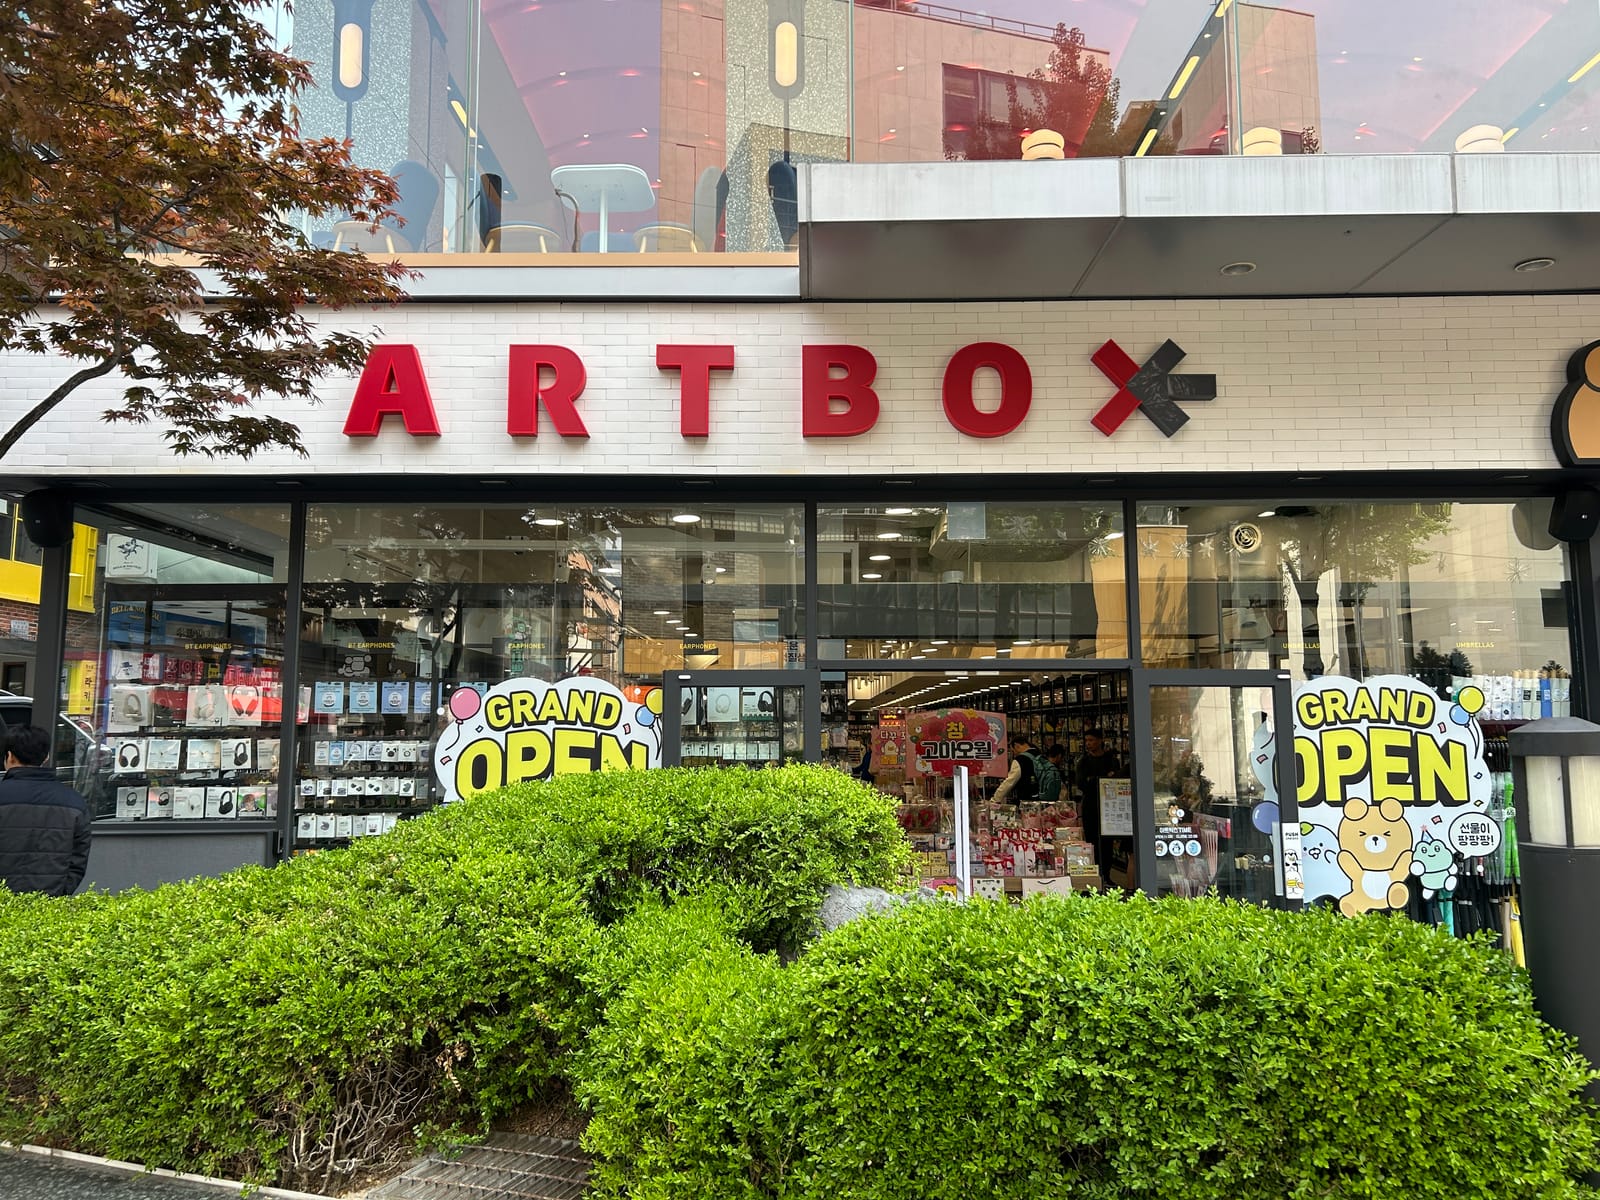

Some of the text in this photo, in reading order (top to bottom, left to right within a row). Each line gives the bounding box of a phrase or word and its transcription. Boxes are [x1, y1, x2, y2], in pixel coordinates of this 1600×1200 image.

[342, 338, 1217, 438] ARTBOX
[195, 642, 232, 650] EARPHONES
[485, 688, 623, 732] GRAND
[1297, 687, 1435, 729] GRAND
[946, 721, 965, 740] 참
[921, 740, 993, 760] 고마오월
[1460, 822, 1490, 835] 선물이
[1458, 835, 1494, 847] 팡팡팡!
